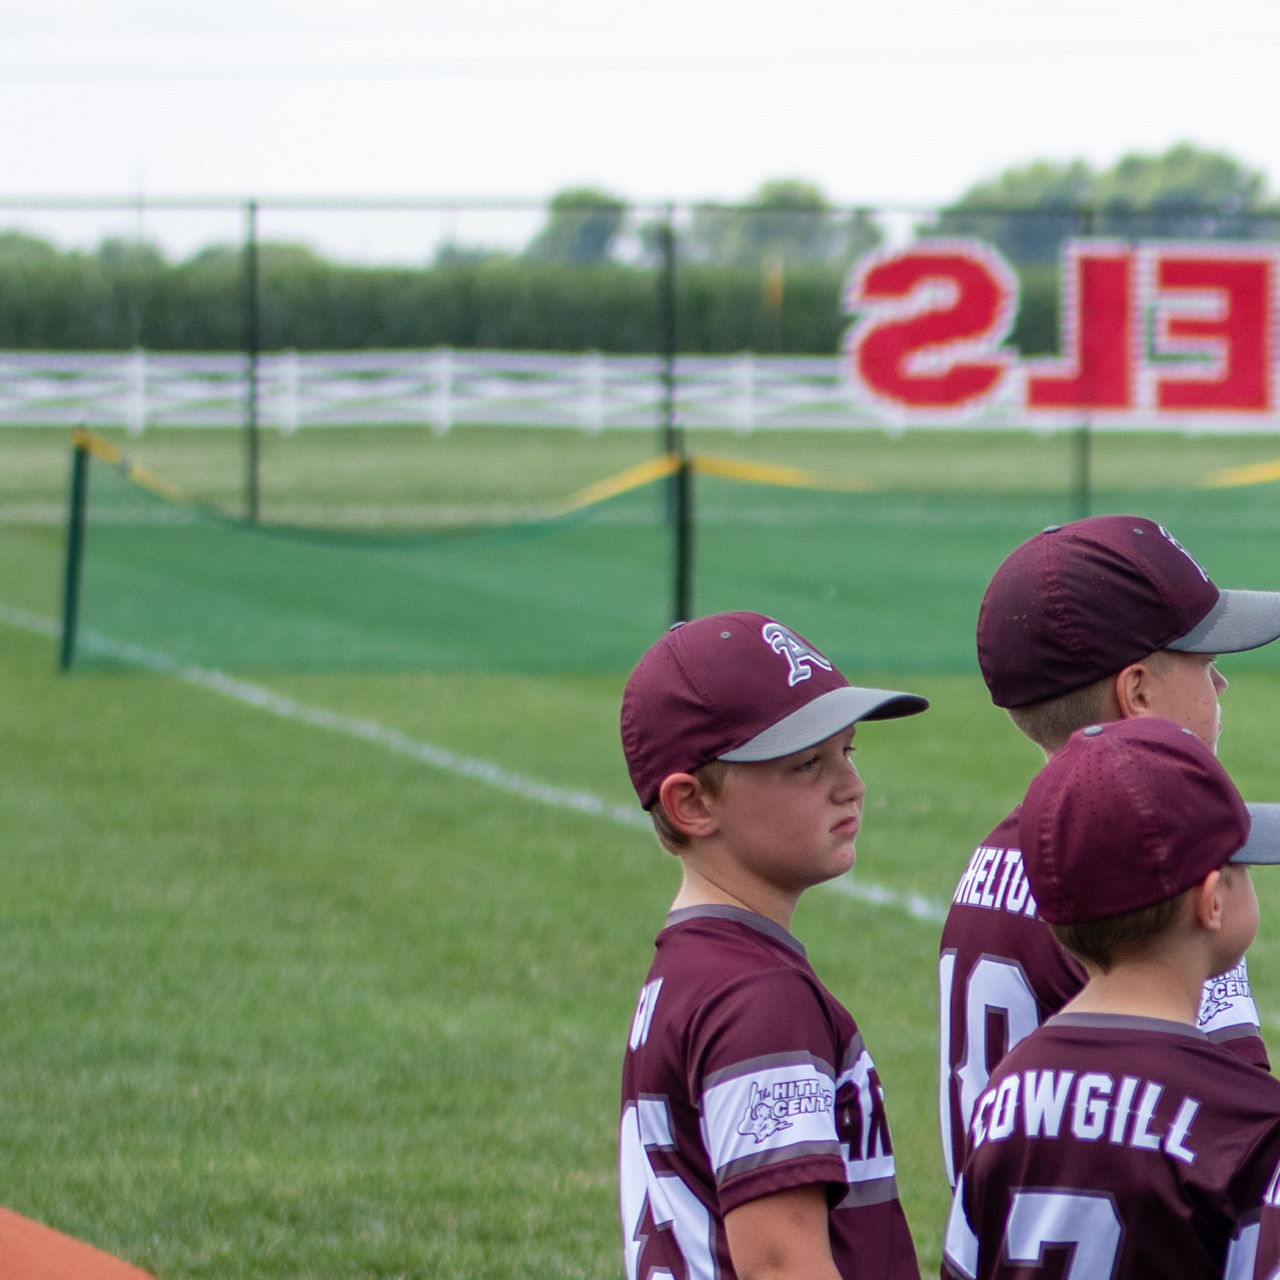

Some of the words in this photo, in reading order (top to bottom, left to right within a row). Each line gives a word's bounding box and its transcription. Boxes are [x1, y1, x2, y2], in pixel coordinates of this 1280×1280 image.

[763, 622, 833, 687] A
[952, 846, 1039, 918] HELTO
[773, 1095, 832, 1119] CENT
[972, 1068, 1202, 1165] COWGILL
